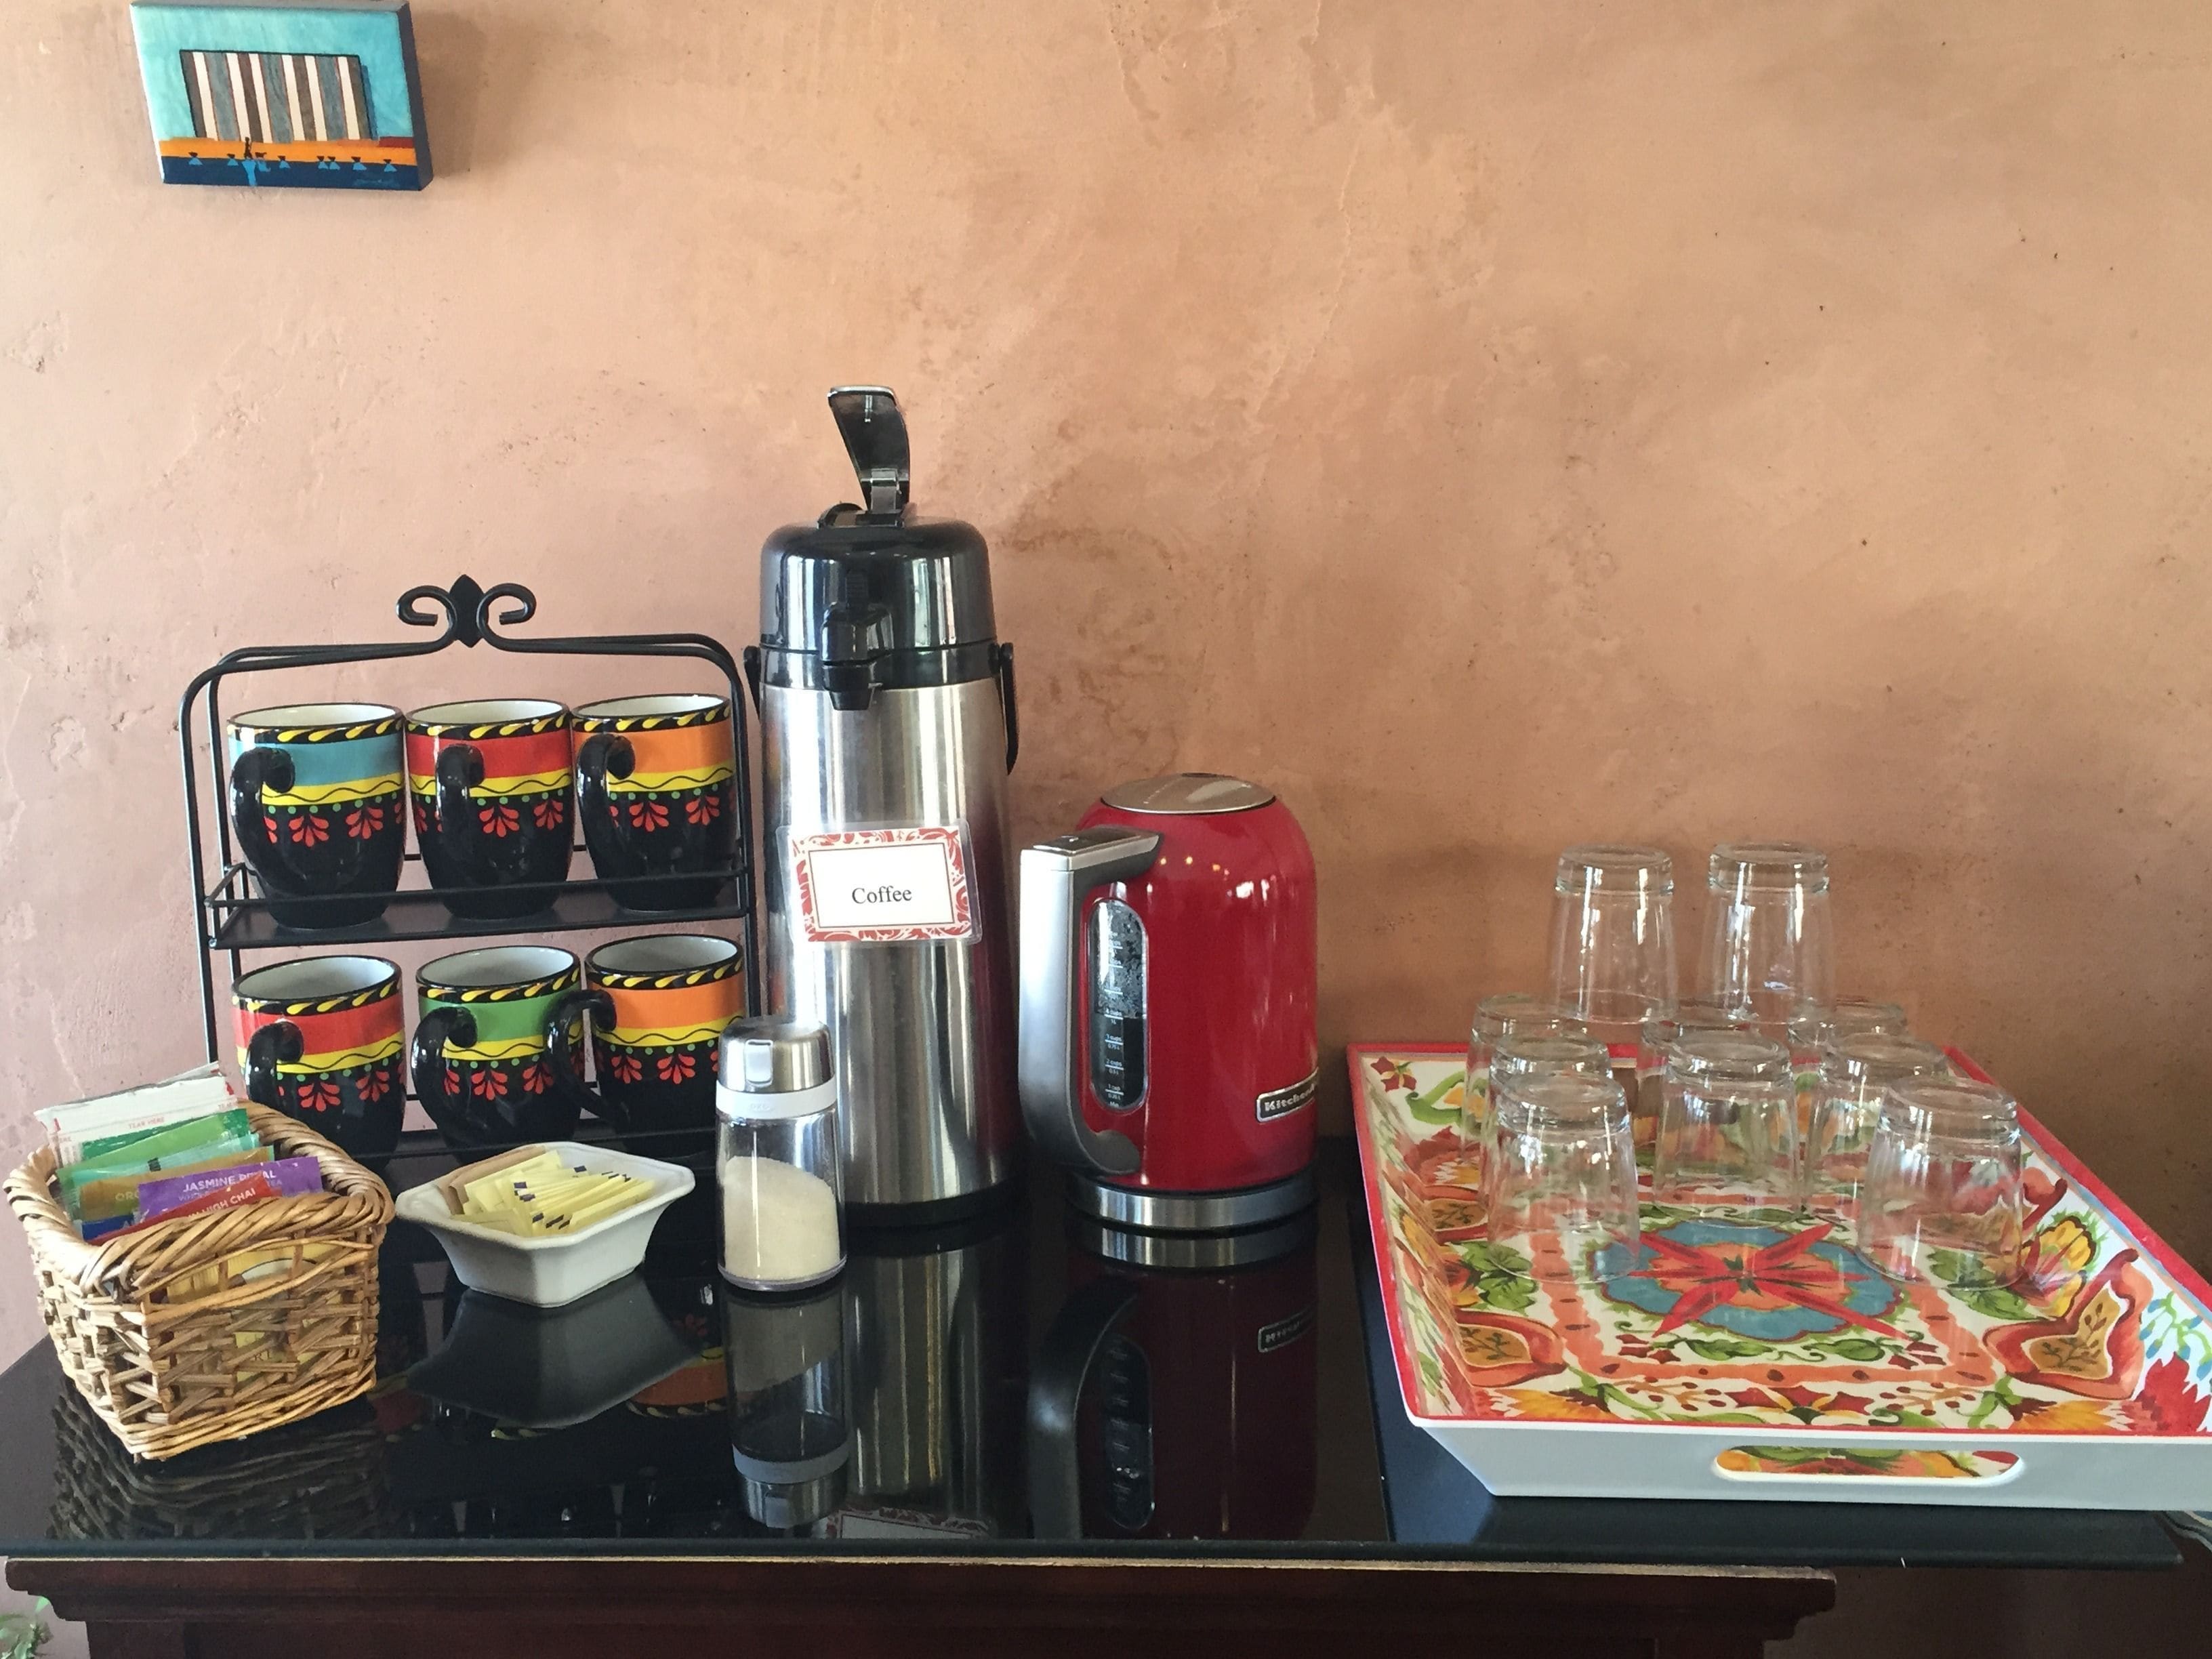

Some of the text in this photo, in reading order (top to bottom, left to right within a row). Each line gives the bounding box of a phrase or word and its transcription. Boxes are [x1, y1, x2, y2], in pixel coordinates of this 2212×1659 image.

[851, 885, 913, 904] Coffee
[183, 1169, 277, 1193] JASMINE PAL
[230, 1187, 256, 1204] CHAI
